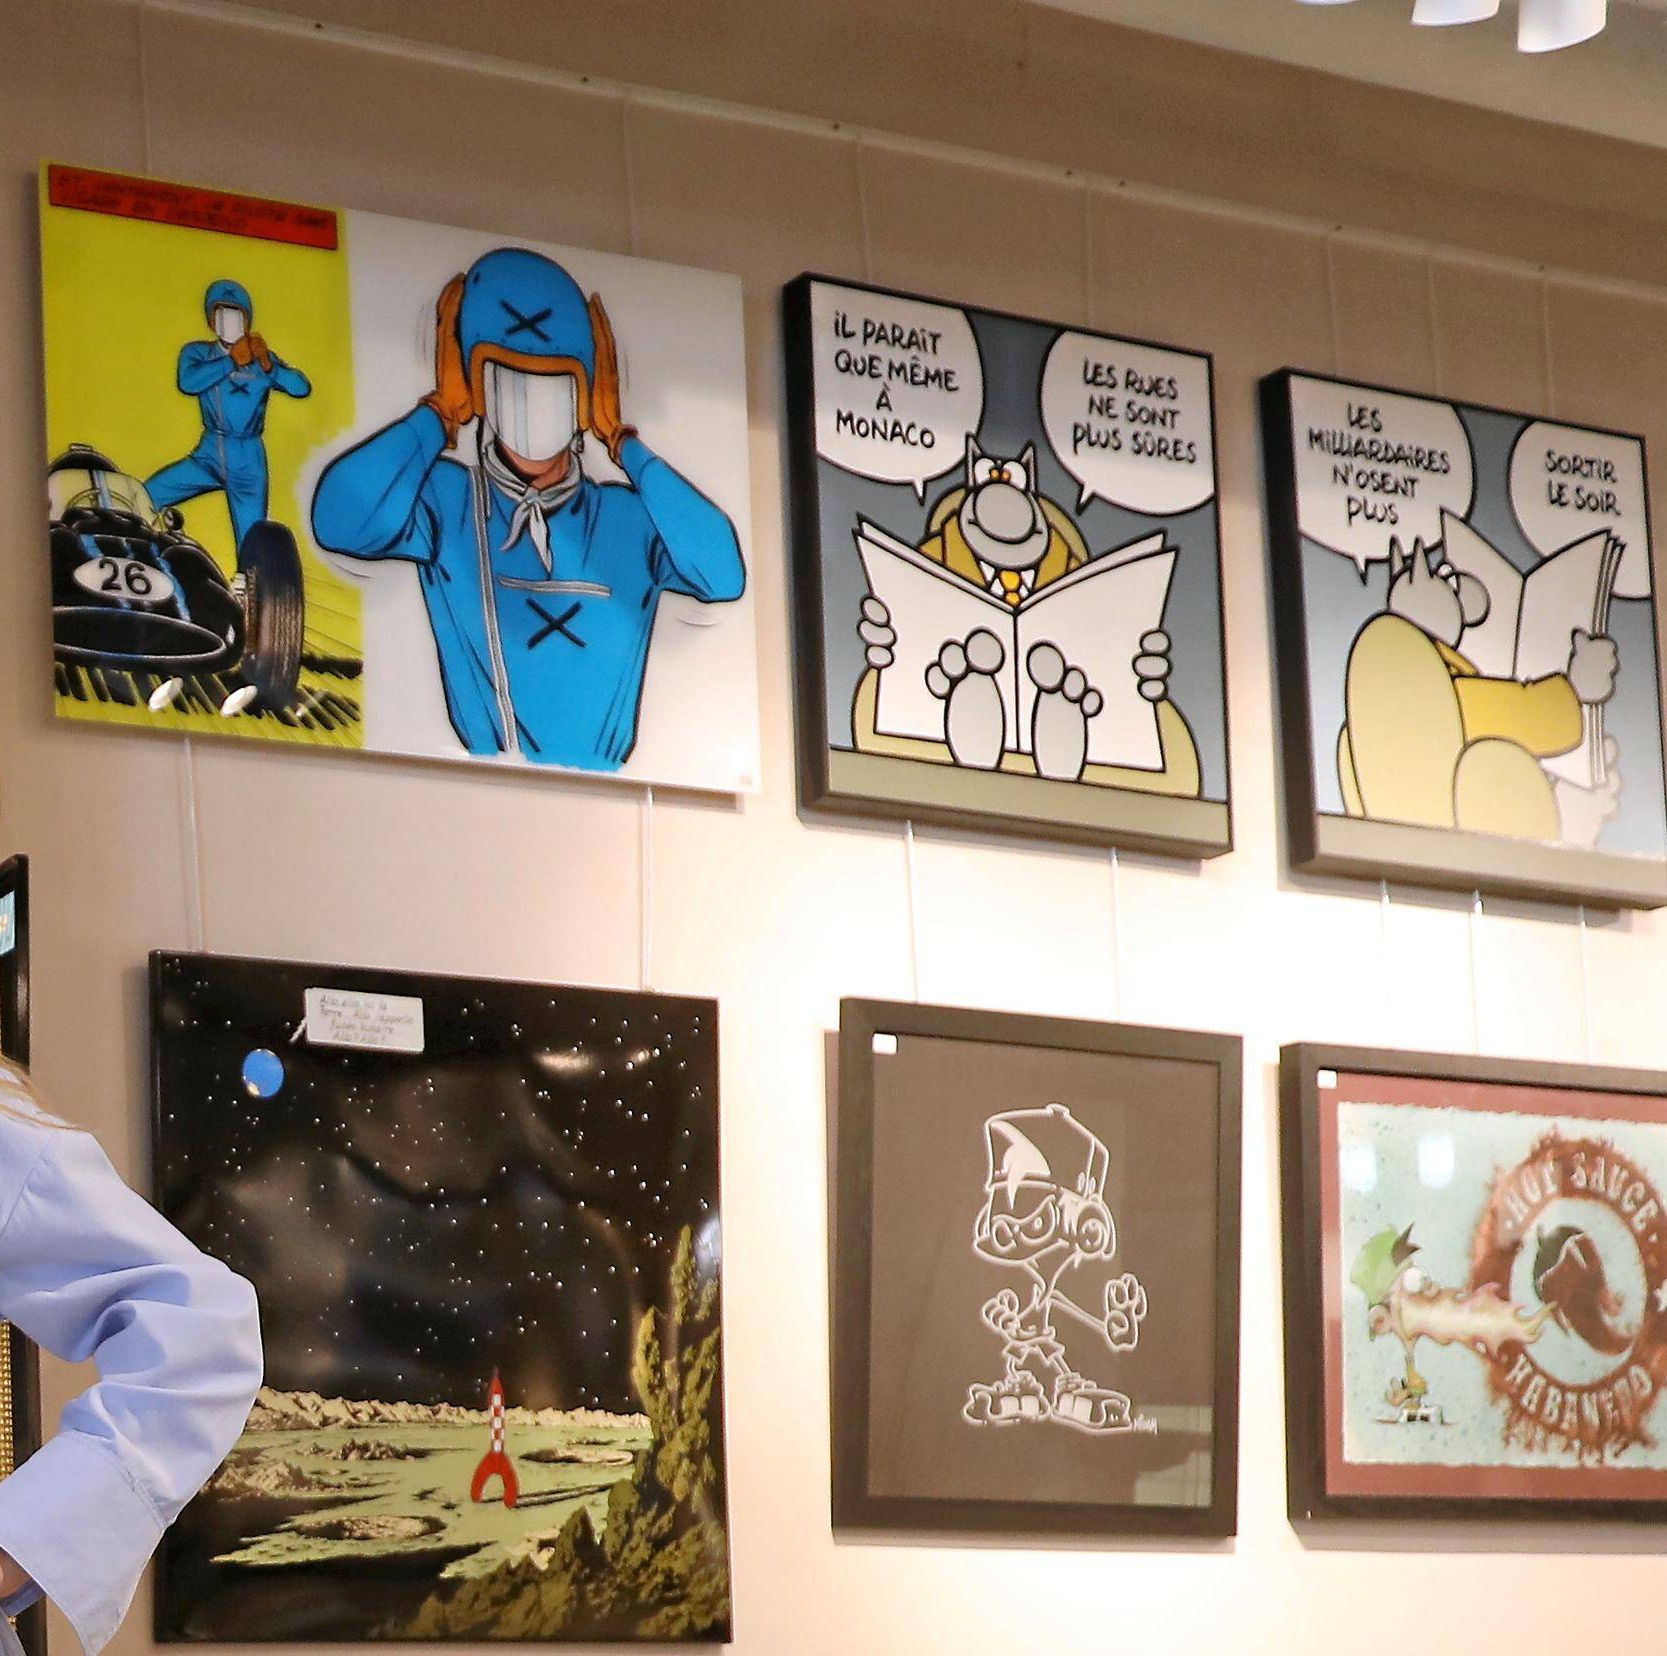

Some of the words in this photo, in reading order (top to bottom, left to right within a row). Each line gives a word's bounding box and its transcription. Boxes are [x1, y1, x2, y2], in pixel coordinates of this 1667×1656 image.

[834, 348, 883, 379] QUE
[888, 354, 960, 392] MÊME
[1083, 355, 1118, 389] LES
[1125, 367, 1179, 400] RUES
[836, 407, 936, 449] MONACO
[1088, 394, 1119, 419] NE
[1125, 398, 1181, 430] SONT
[1347, 401, 1383, 433] LES
[1073, 420, 1122, 456] PLUS
[1332, 461, 1419, 498] N'OSENT
[1545, 447, 1618, 484] SORTIR
[1347, 494, 1400, 527] PLUS
[1547, 477, 1569, 507] LE
[1574, 484, 1622, 517] SOIR
[98, 558, 153, 596] 26
[1505, 1158, 1559, 1224] HOT
[1569, 1150, 1659, 1232] SAUCE
